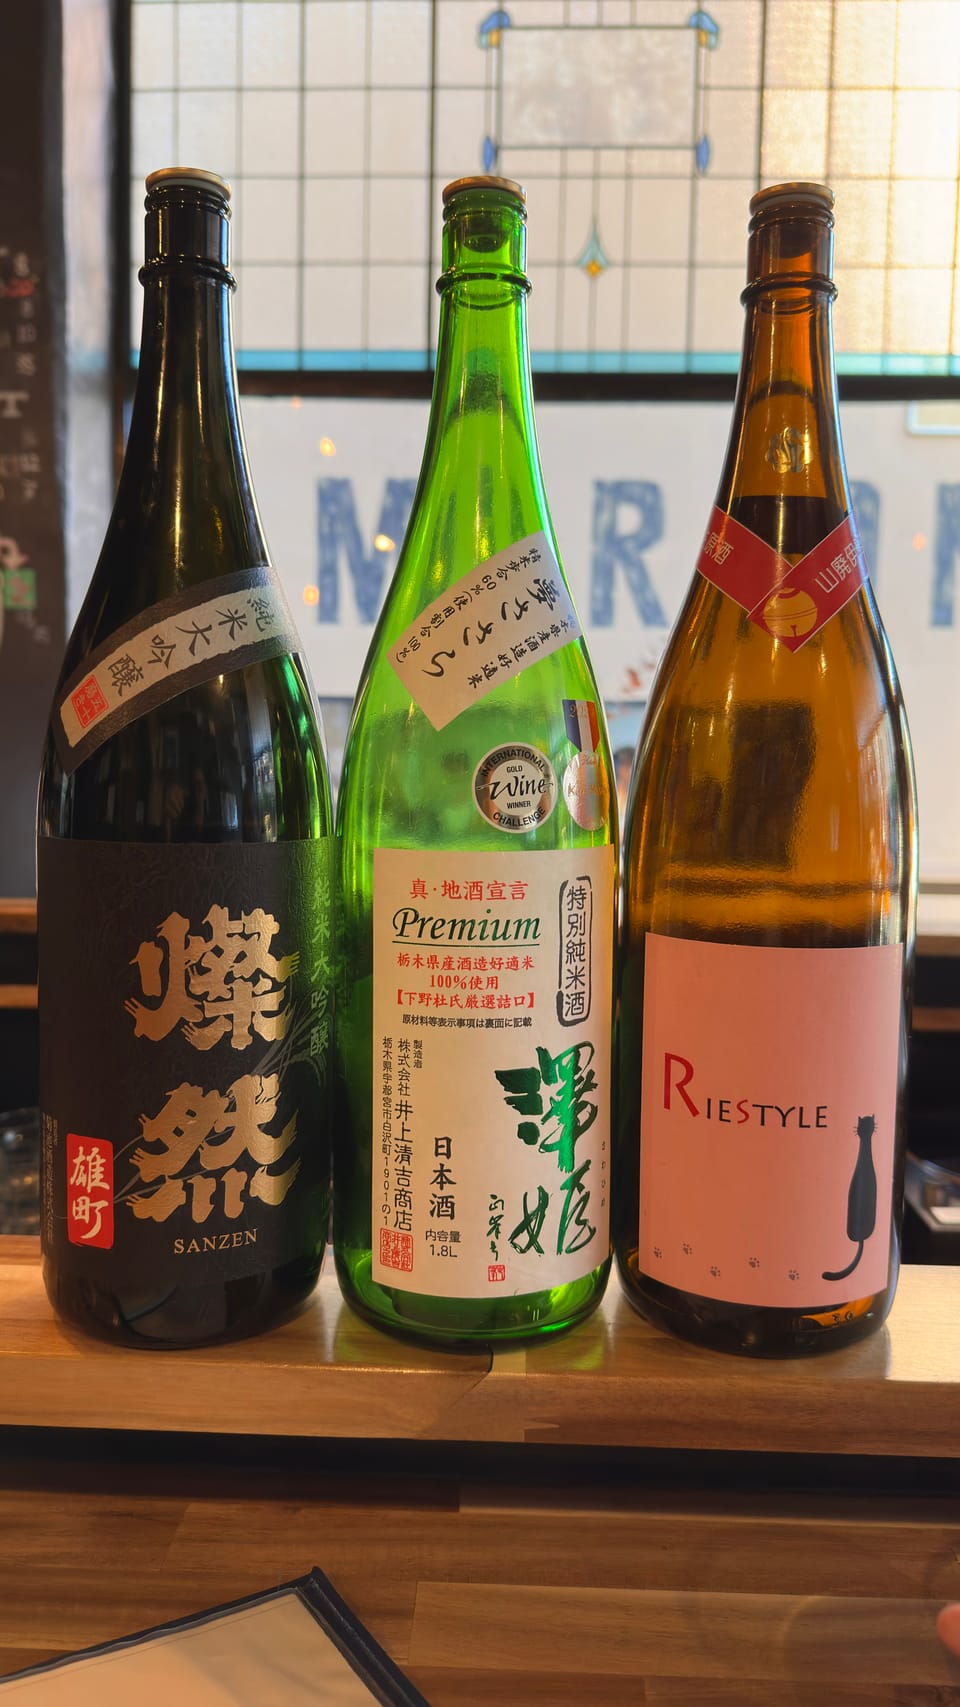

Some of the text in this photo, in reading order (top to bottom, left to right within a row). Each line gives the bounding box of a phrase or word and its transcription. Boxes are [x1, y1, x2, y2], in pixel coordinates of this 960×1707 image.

[421, 578, 561, 678] 夢ささら
[107, 598, 275, 697] 純米大吟醸
[481, 748, 547, 777] INTERNATIONAL
[506, 765, 523, 773] GOLD
[493, 806, 546, 827] CHALLENGE
[506, 800, 531, 809] WINNER
[392, 907, 541, 941] Premium
[397, 953, 535, 971] 栃木県産酒造好適米
[565, 886, 587, 1018] 特別純米酒
[124, 903, 301, 1222] 燦然
[70, 1145, 110, 1240] 雄町
[429, 1136, 457, 1221] 日本酒
[174, 1228, 258, 1255] SANZEN
[425, 1228, 462, 1244] 内容量
[429, 1244, 458, 1258] 1.8L
